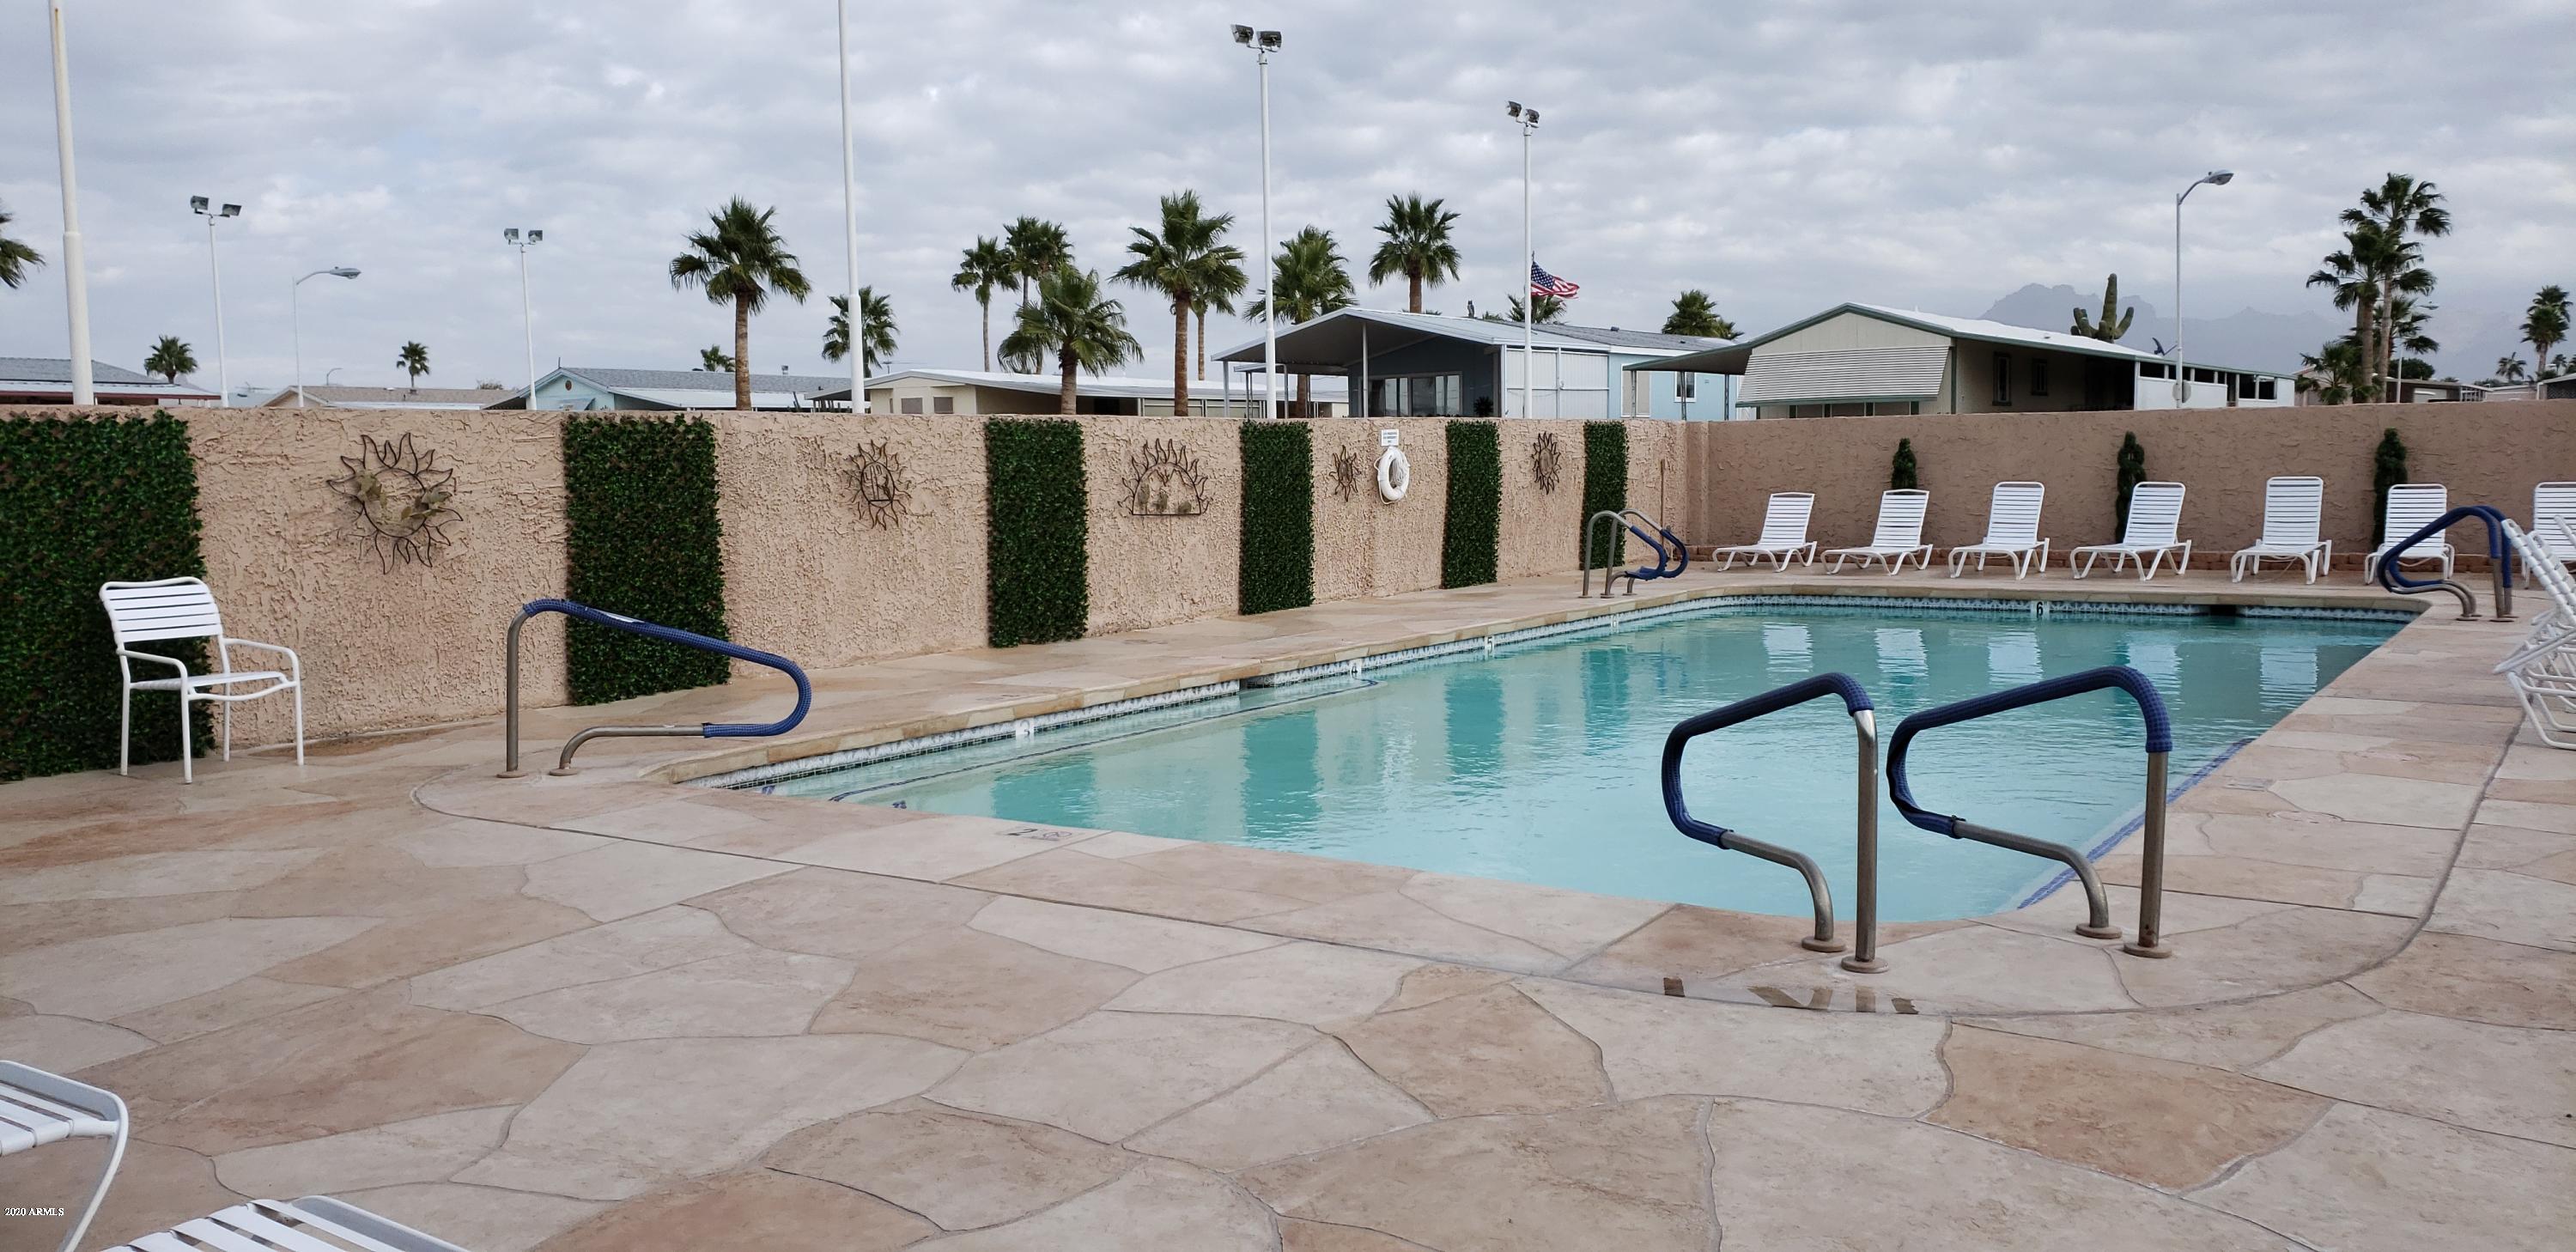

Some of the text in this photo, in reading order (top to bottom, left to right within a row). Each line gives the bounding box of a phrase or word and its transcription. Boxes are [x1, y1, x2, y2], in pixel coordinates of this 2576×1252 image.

[2037, 602, 2043, 617] 6
[1487, 636, 1493, 653] 5
[1020, 720, 1030, 735] 3
